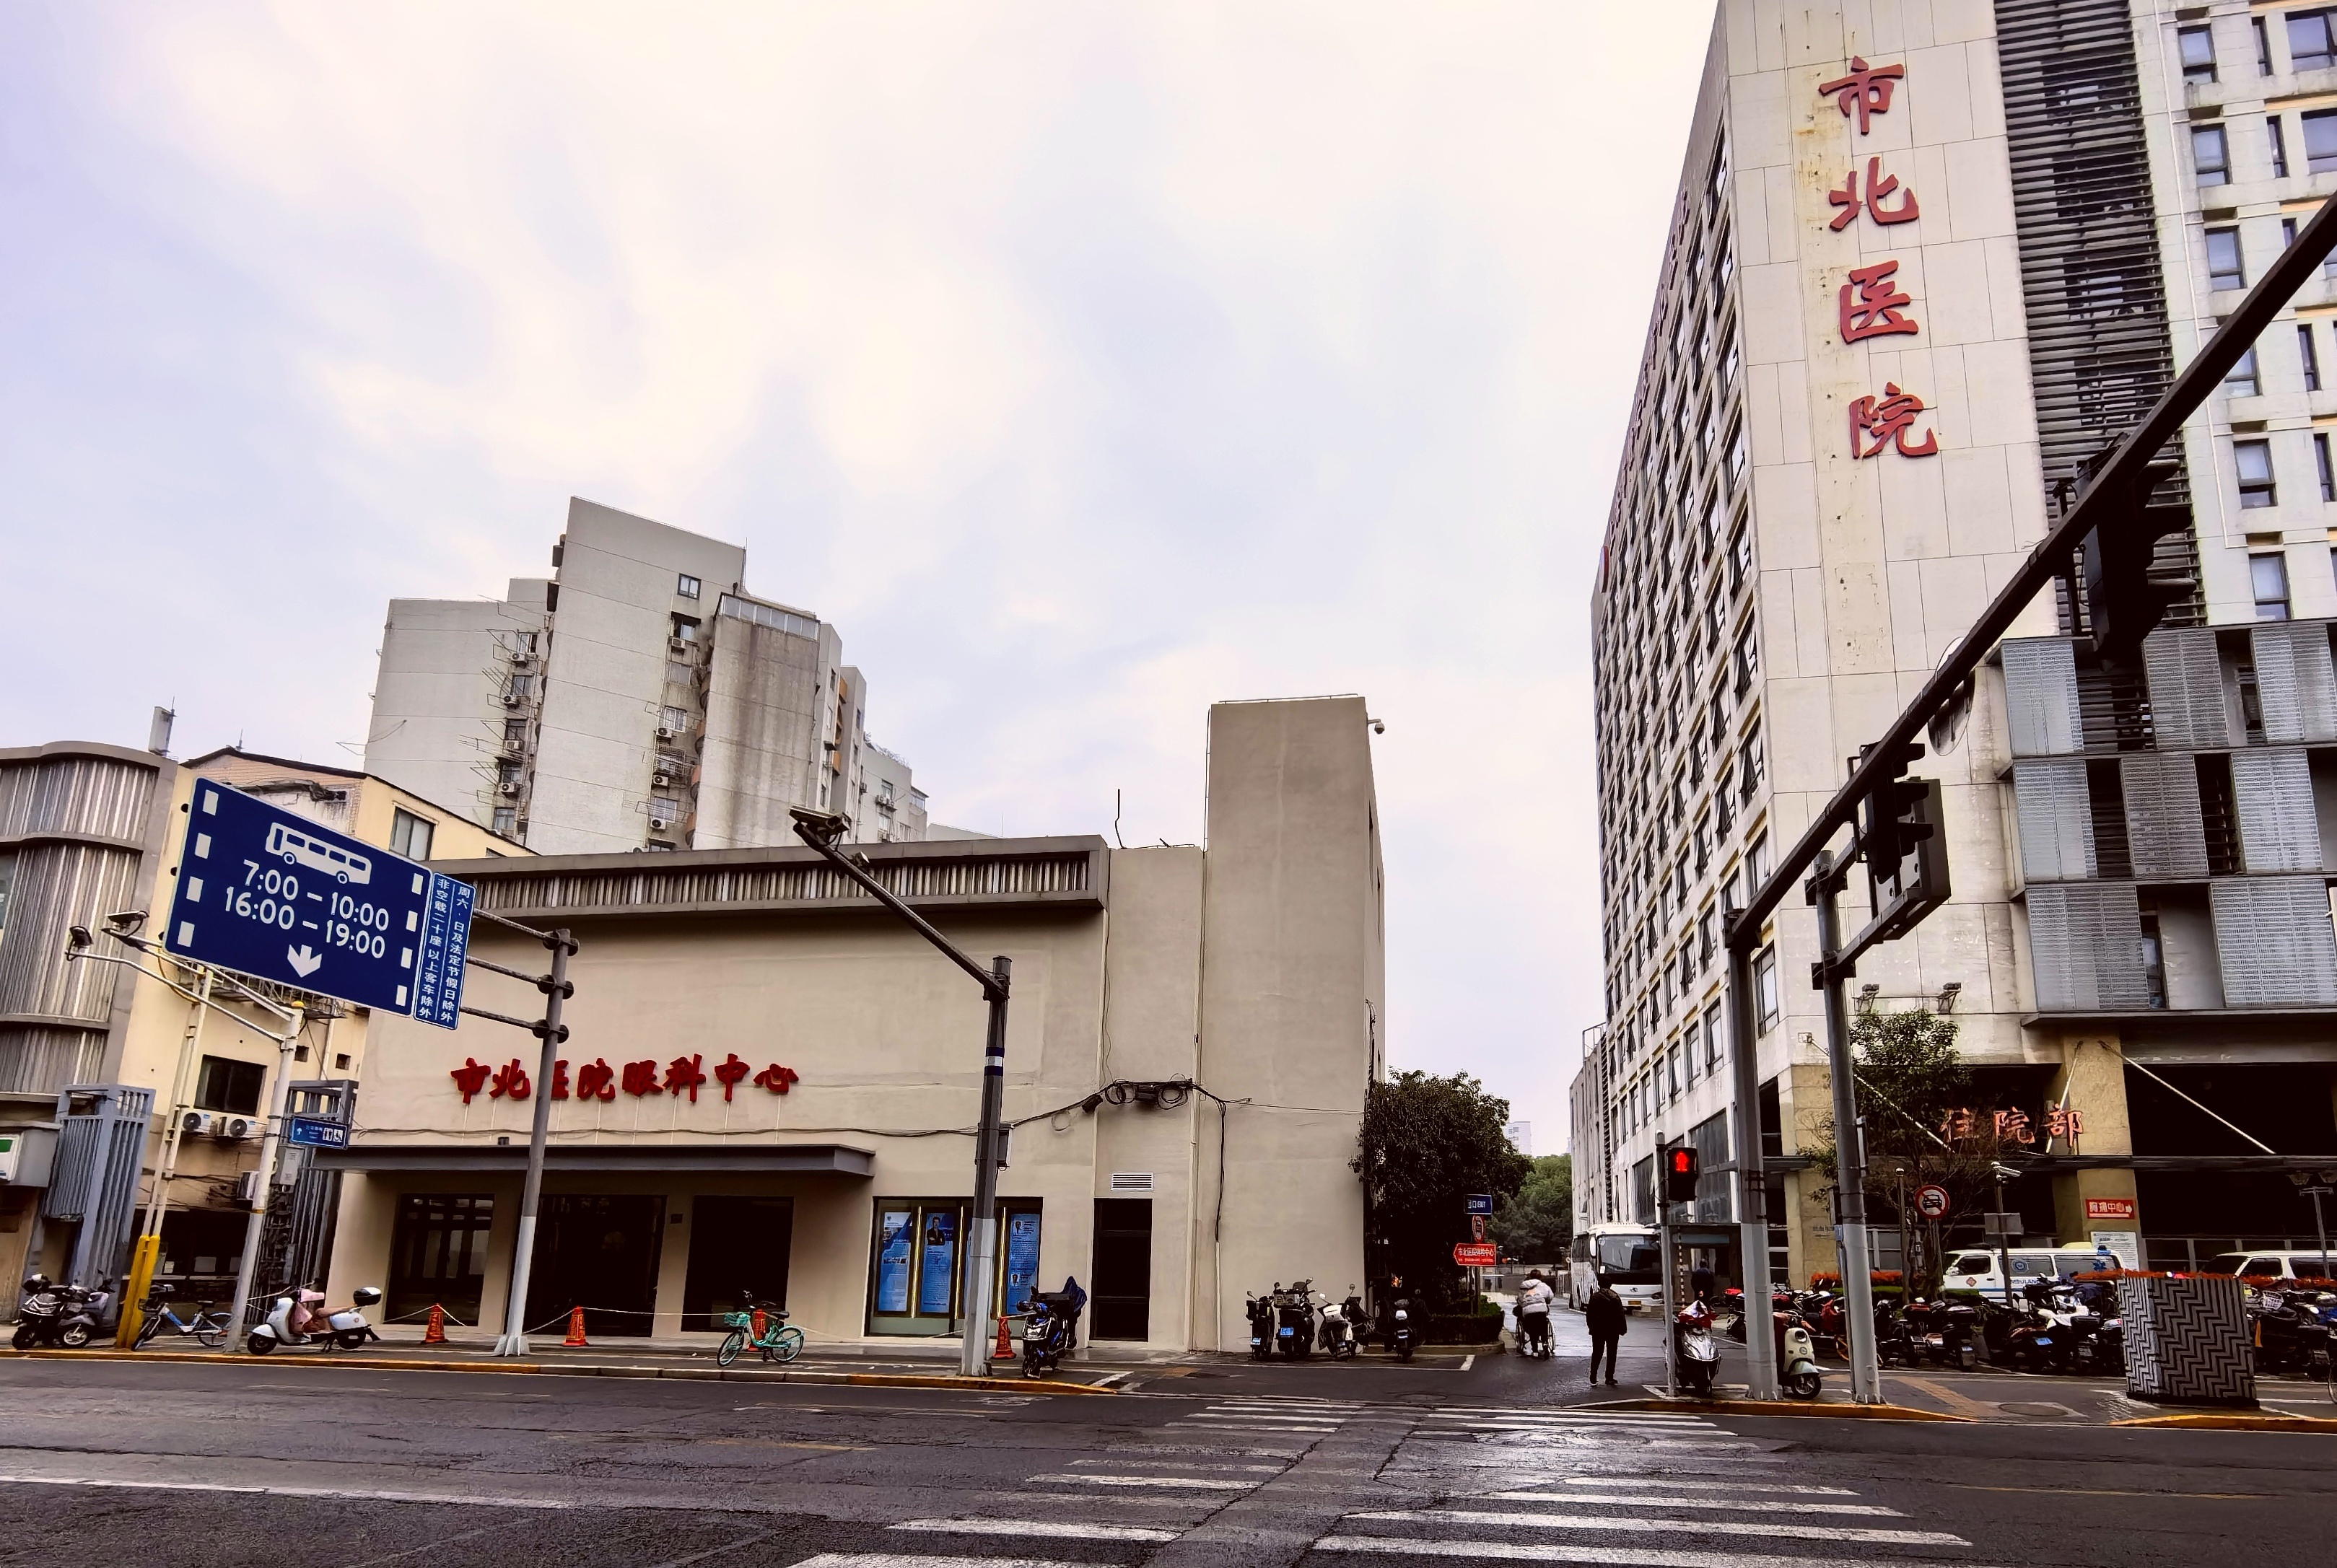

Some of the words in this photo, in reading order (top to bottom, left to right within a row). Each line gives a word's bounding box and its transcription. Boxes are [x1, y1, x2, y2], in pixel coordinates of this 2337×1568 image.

[1818, 55, 1939, 460] 市北医院
[225, 886, 294, 930] 16:00
[326, 919, 385, 958] 19:00
[243, 859, 299, 901] 7:00
[331, 891, 389, 931] 10:00
[418, 878, 450, 1019] 非空载二十座以上客车除外
[1938, 1103, 2084, 1149] 住院部
